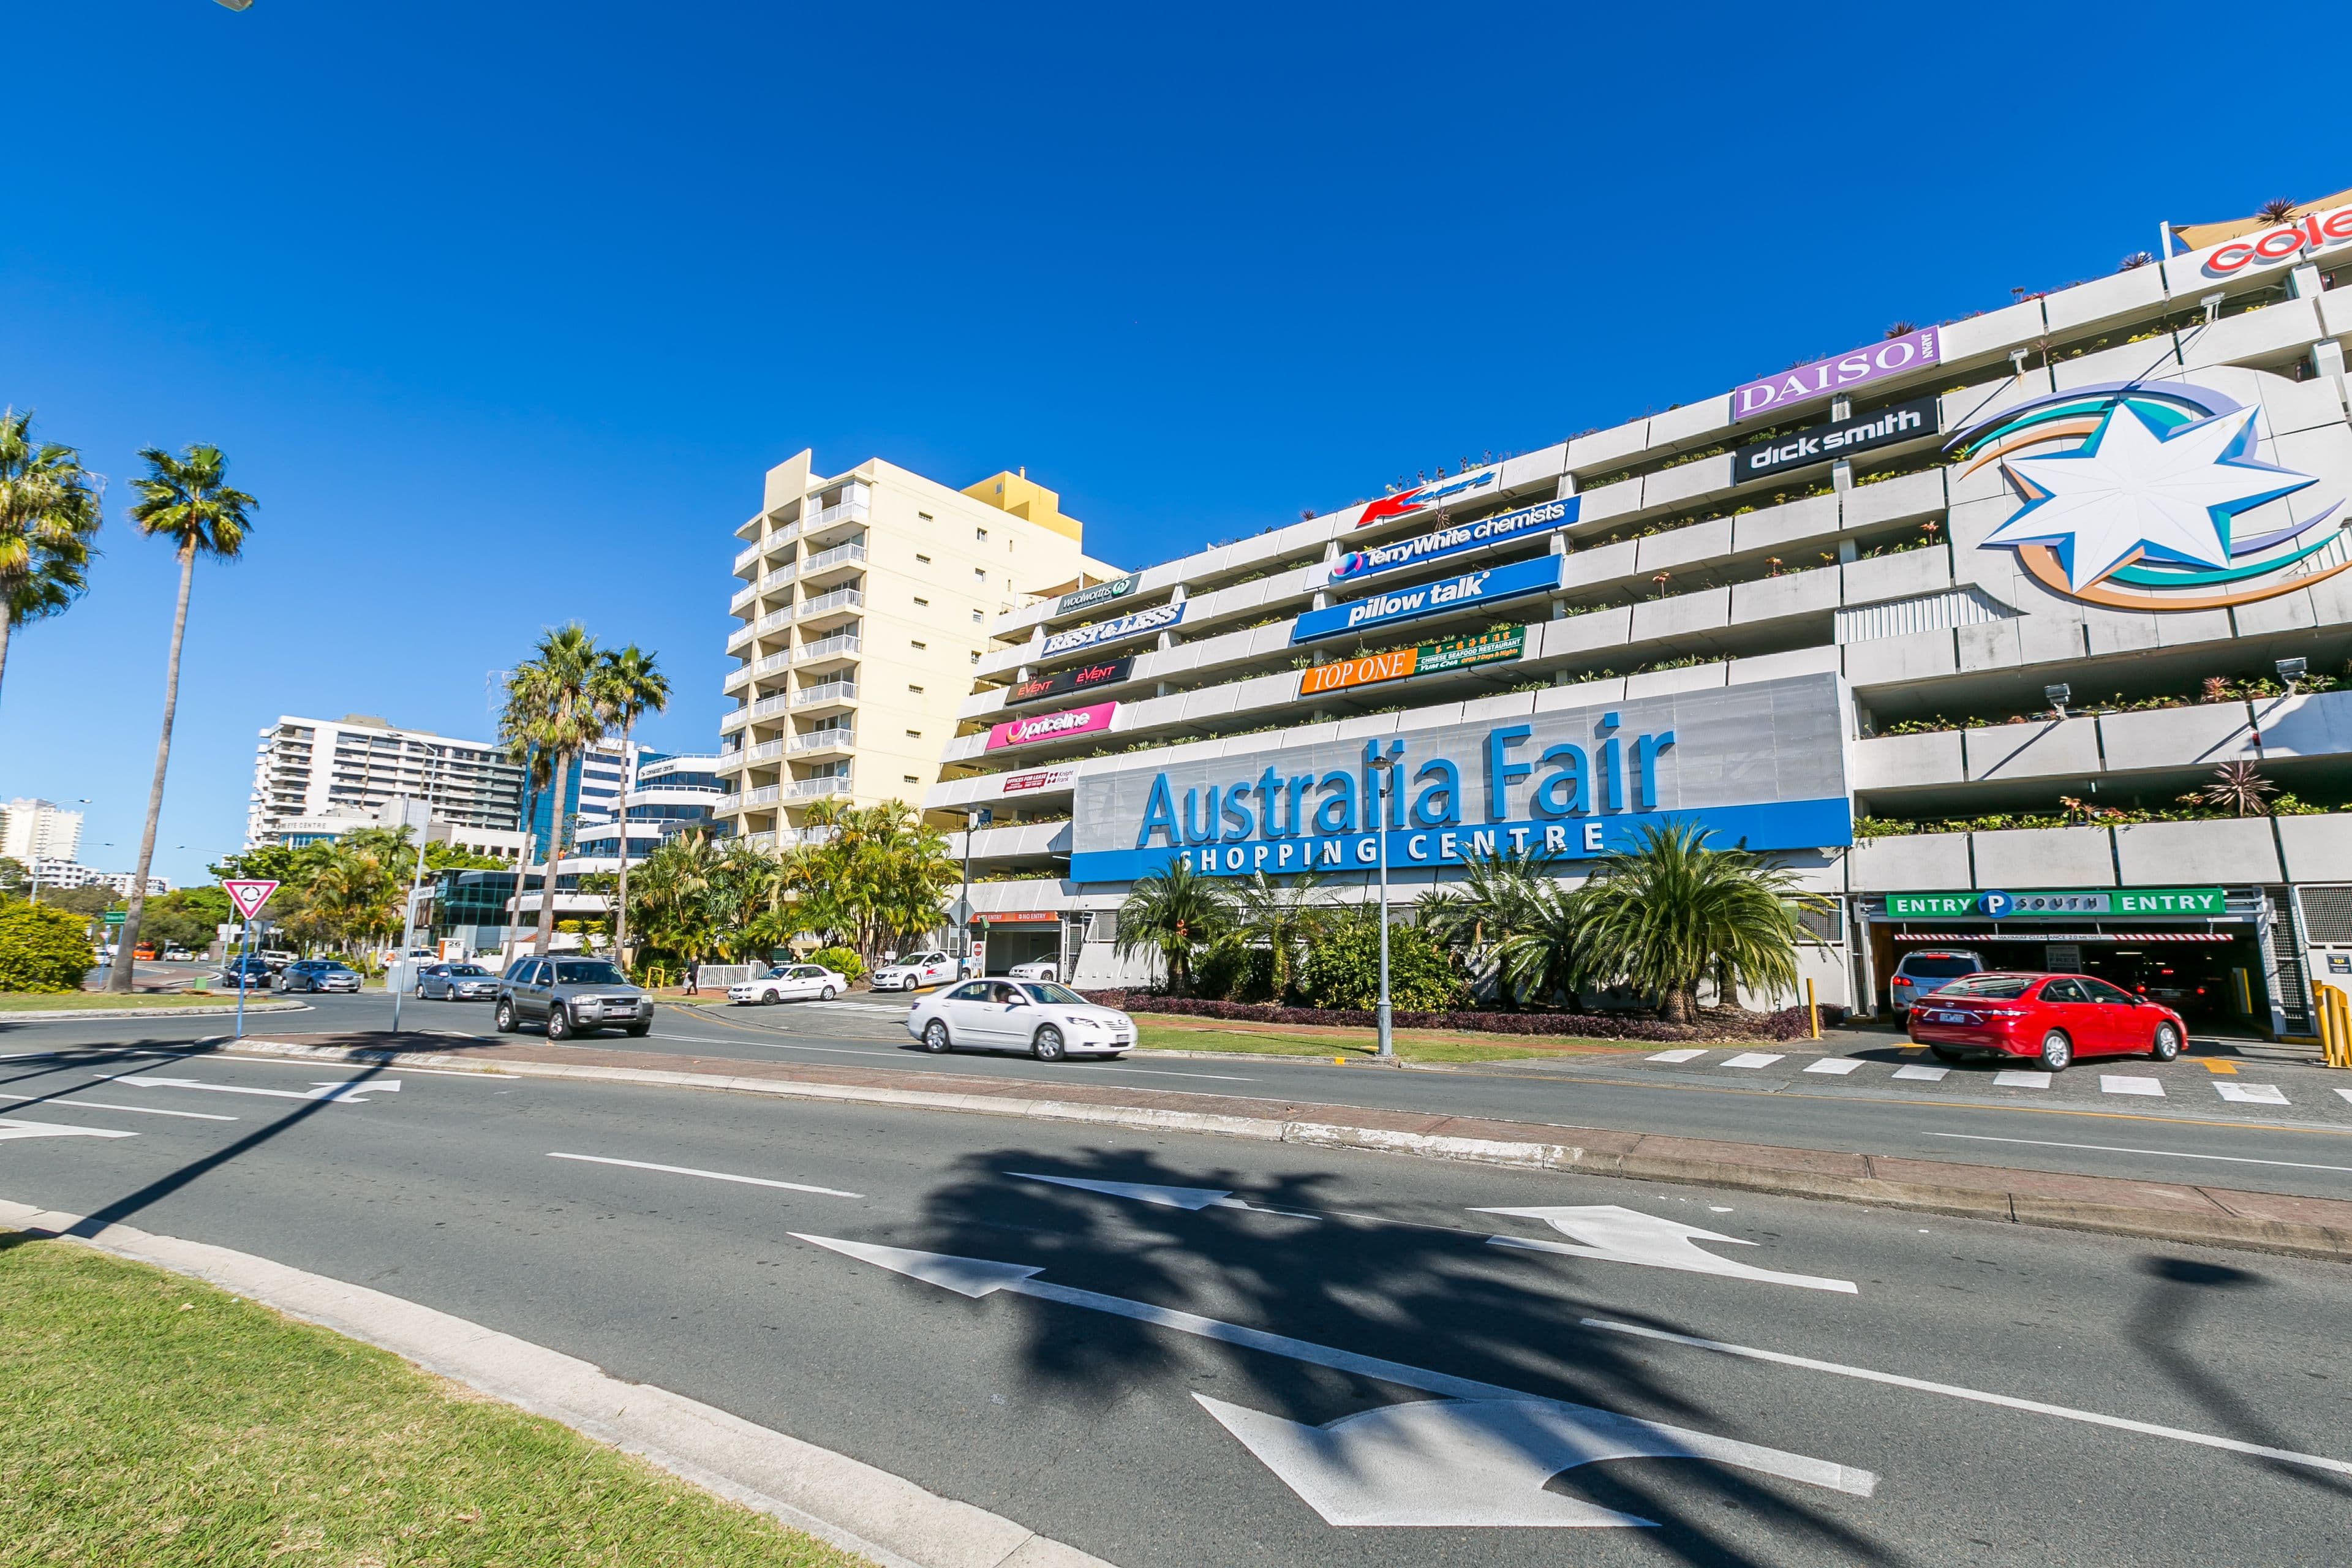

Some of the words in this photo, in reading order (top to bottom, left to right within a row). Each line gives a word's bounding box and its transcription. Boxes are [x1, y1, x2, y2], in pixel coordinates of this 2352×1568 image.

[1921, 333, 1934, 360] JAPAN
[1739, 342, 1915, 413] DAISO
[1751, 436, 1820, 469] dick
[1823, 410, 1921, 450] smith
[1474, 503, 1566, 540] chemists
[1348, 592, 1426, 627] pillow
[1430, 575, 1484, 604] talk
[1044, 626, 1104, 654] BEST
[1117, 603, 1182, 635] LESS
[1421, 654, 1446, 664] CHINESE
[1448, 649, 1477, 659] SEAFOOD
[1479, 639, 1521, 654] RESTAURANT
[1499, 648, 1518, 657] Nights
[1017, 680, 1054, 696] EVENT
[1076, 666, 1117, 683] EVENT
[1314, 663, 1353, 690] TOP
[1359, 653, 1406, 682] ONE
[1025, 712, 1090, 739] priceline
[1137, 739, 1461, 846] Australia
[1491, 712, 1676, 819] Fair
[1180, 838, 1376, 872] SHOPPING
[1408, 823, 1604, 859] CENTRE
[1897, 899, 1971, 912] ENTRY
[1988, 895, 2005, 913] P
[2020, 897, 2098, 907] SOUTH
[2122, 895, 2214, 910] ENTRY
